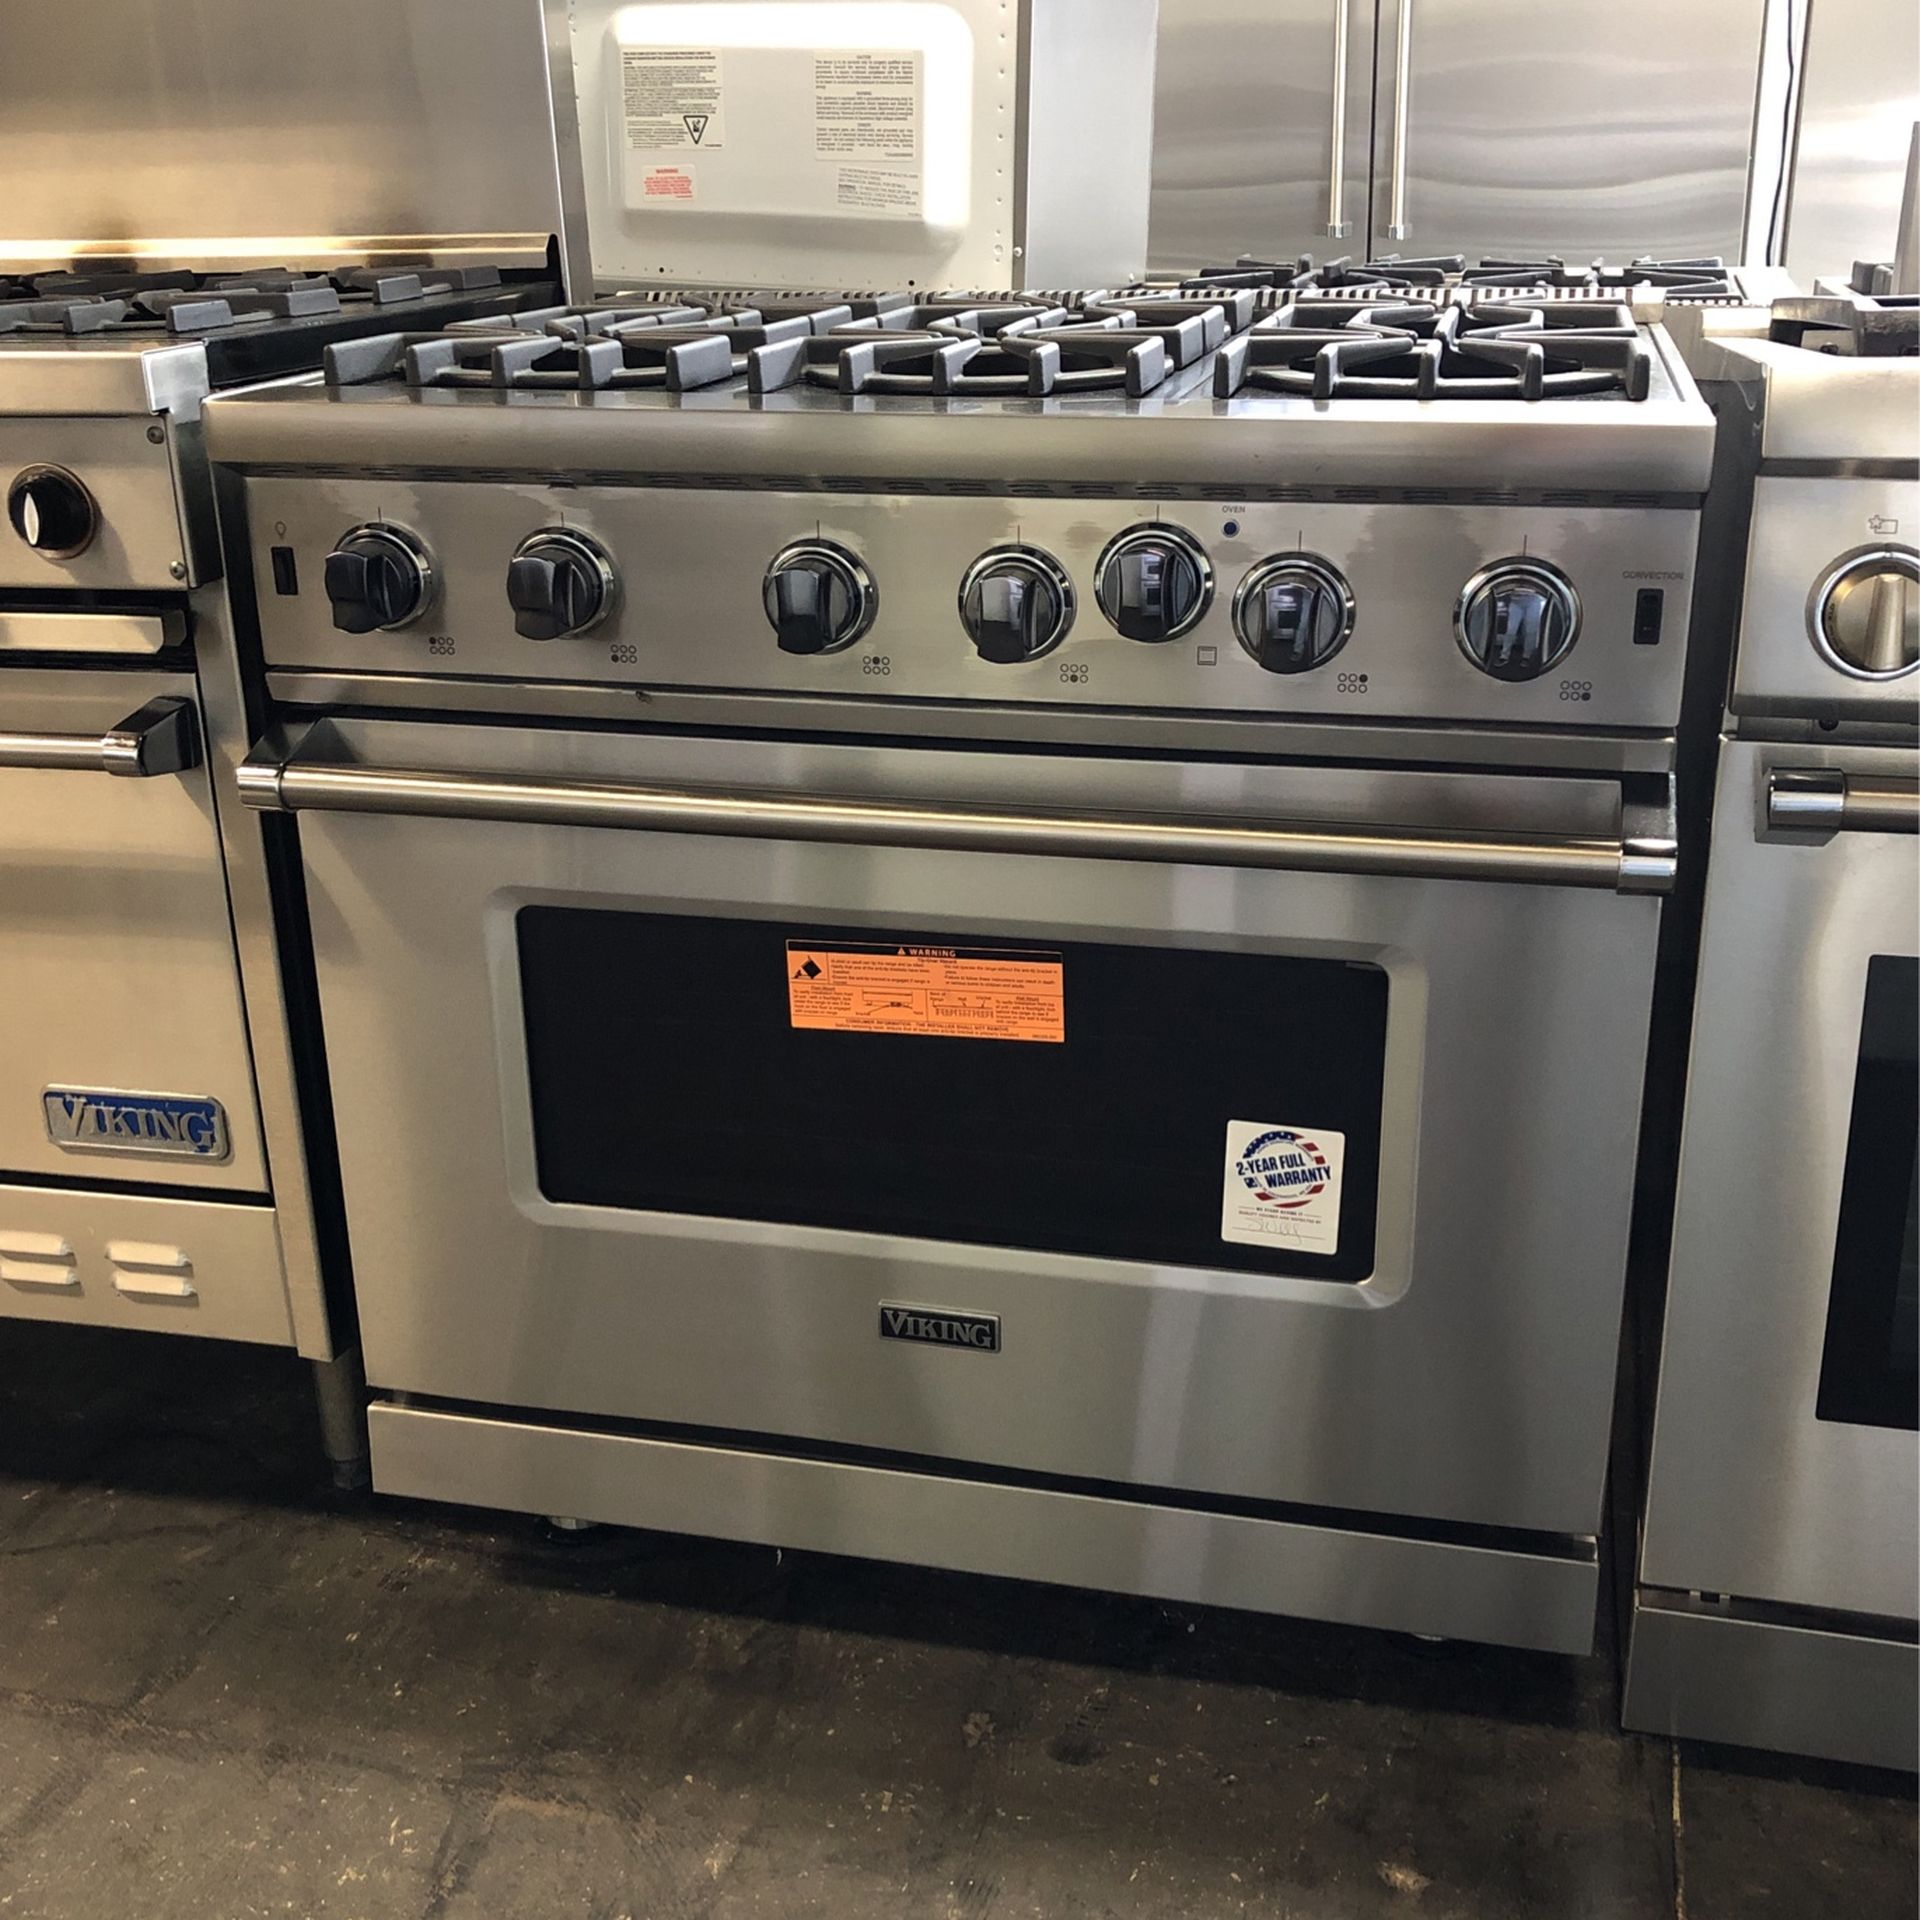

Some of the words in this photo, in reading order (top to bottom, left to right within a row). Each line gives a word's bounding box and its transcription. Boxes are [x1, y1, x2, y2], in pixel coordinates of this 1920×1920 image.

[1222, 505, 1246, 513] OVEN
[1622, 570, 1684, 580] CONVECTION
[908, 948, 957, 958] WARNING
[45, 1094, 214, 1147] VIKING
[1236, 1159, 1278, 1175] 2-YEAR
[1279, 1153, 1306, 1167] FULL
[1265, 1166, 1331, 1187] WARRANTY
[884, 1310, 992, 1347] VIKING
